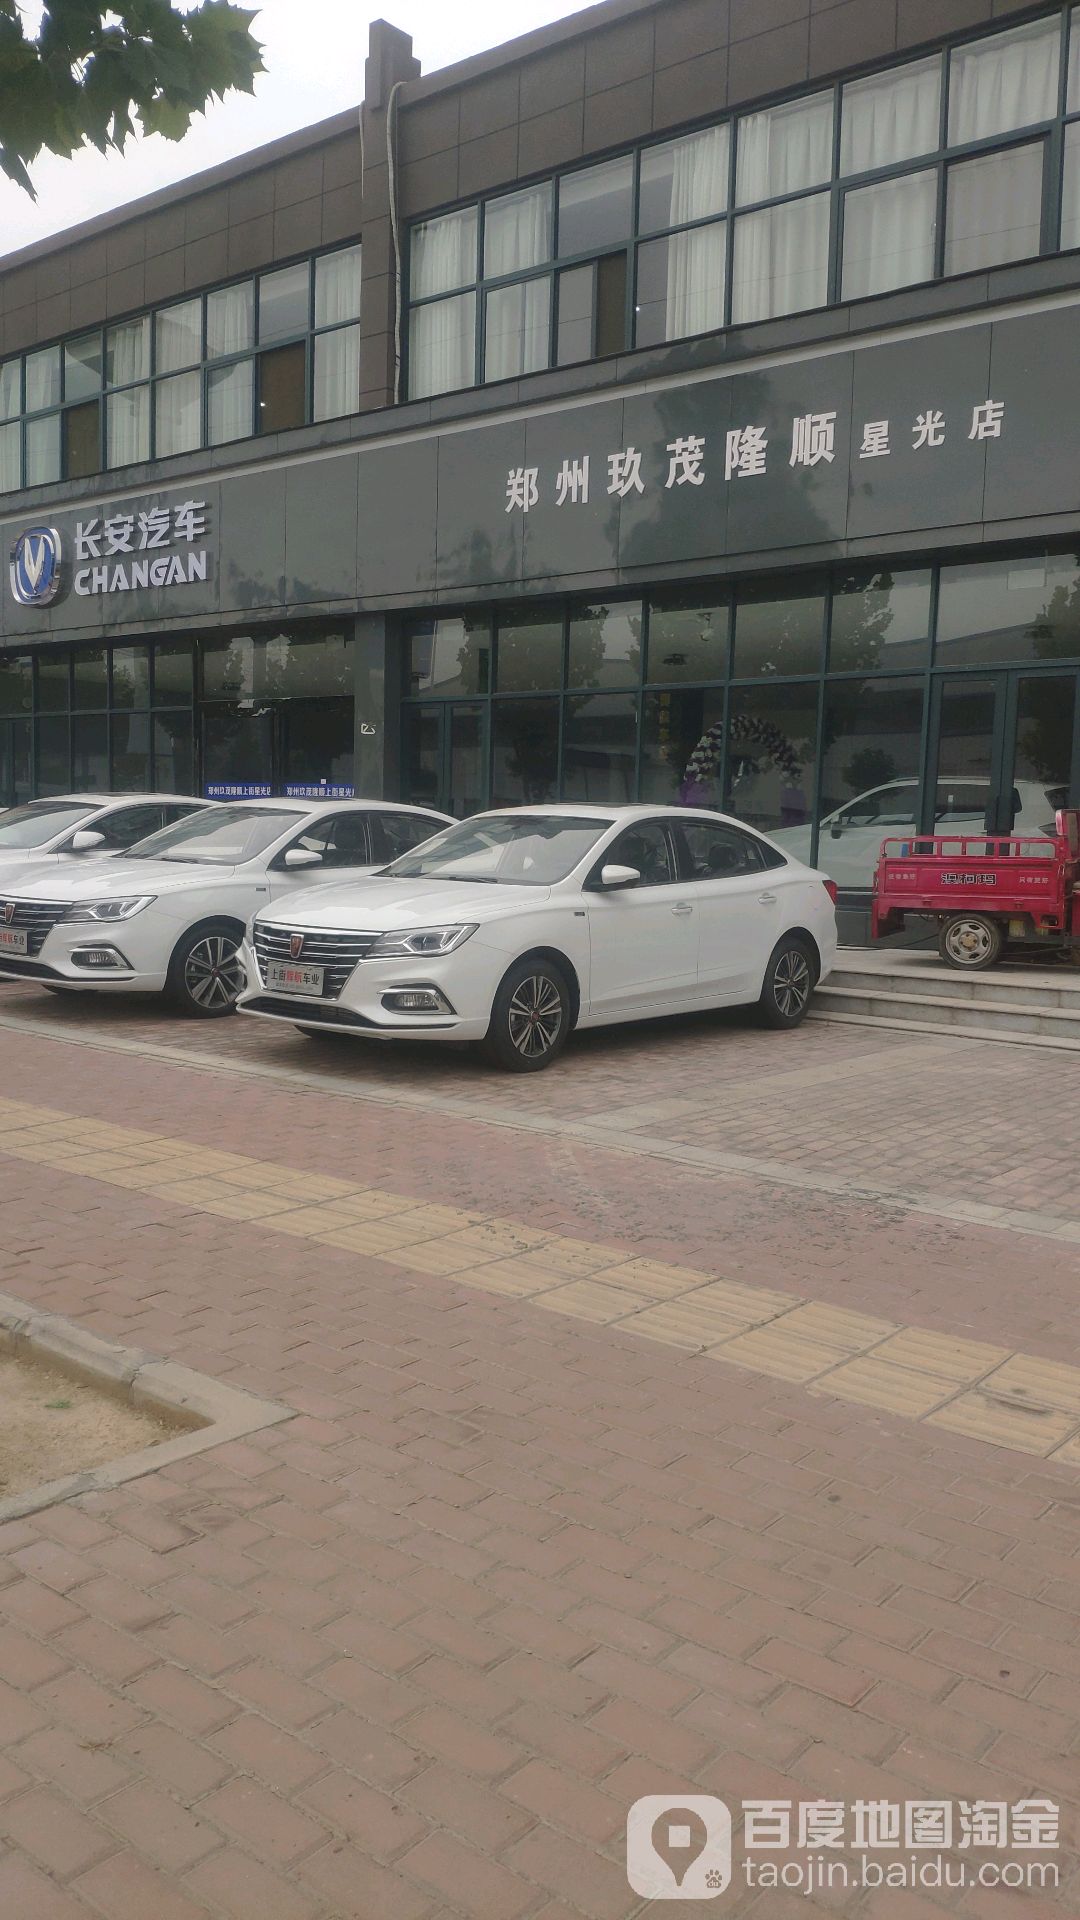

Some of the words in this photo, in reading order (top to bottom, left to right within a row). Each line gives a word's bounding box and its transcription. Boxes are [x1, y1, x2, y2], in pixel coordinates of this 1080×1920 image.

[505, 411, 837, 514] 郑州玖茂隆顺
[859, 400, 1006, 460] 星光店
[74, 500, 206, 560] 长安汽车
[74, 550, 207, 596] CHANGAN
[286, 786, 355, 797] 郑州玖茂隆顺上街星光
[940, 872, 997, 886] 澳柯玛
